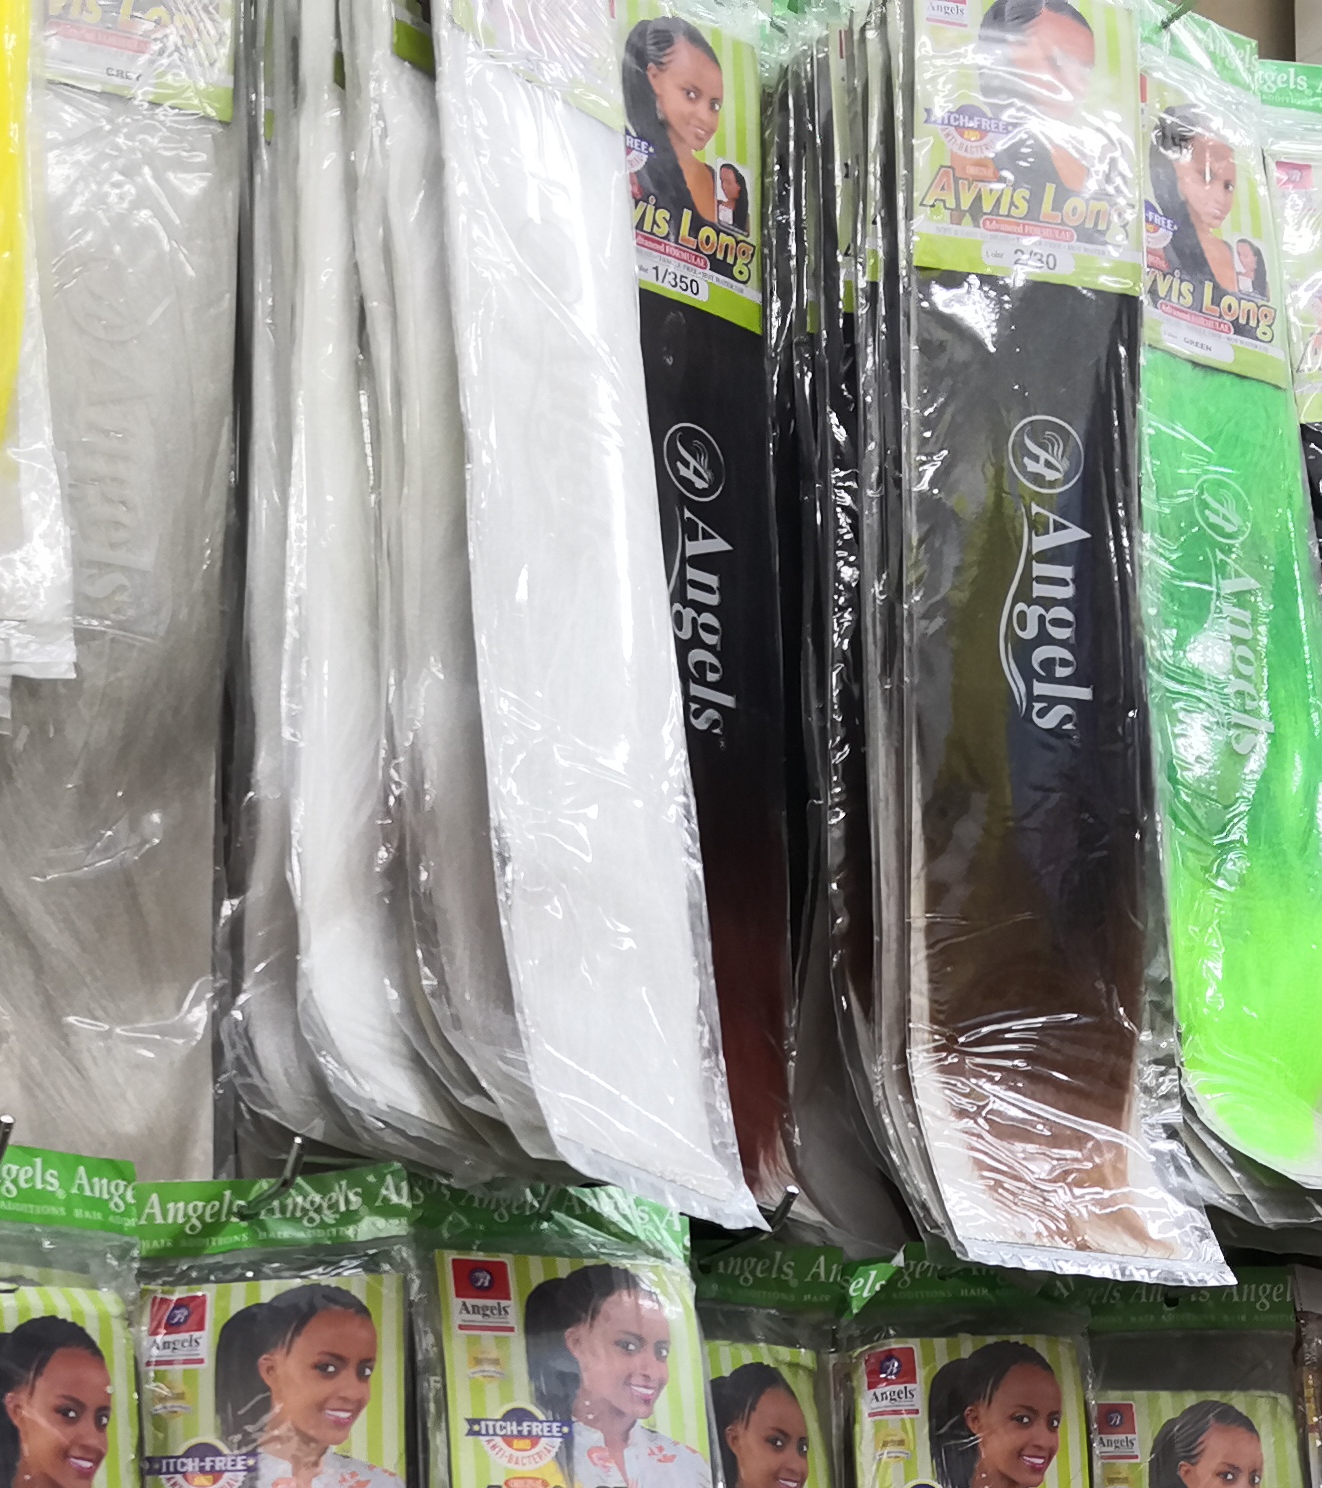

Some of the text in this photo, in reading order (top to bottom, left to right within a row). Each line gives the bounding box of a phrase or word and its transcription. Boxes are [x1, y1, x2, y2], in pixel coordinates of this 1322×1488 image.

[919, 164, 1031, 219] Avvis
[679, 208, 757, 286] Long
[652, 263, 700, 297] 1/350
[1201, 280, 1277, 344] Long
[1182, 336, 1213, 353] GREEN
[672, 508, 737, 736] Angels
[1011, 510, 1095, 733] Angels
[458, 1300, 511, 1319] Angels
[870, 1386, 917, 1404] Angels
[479, 1419, 564, 1438] ITCH-FREE
[1097, 1435, 1137, 1451] Angels
[161, 1455, 249, 1474] ITCH-FREE
